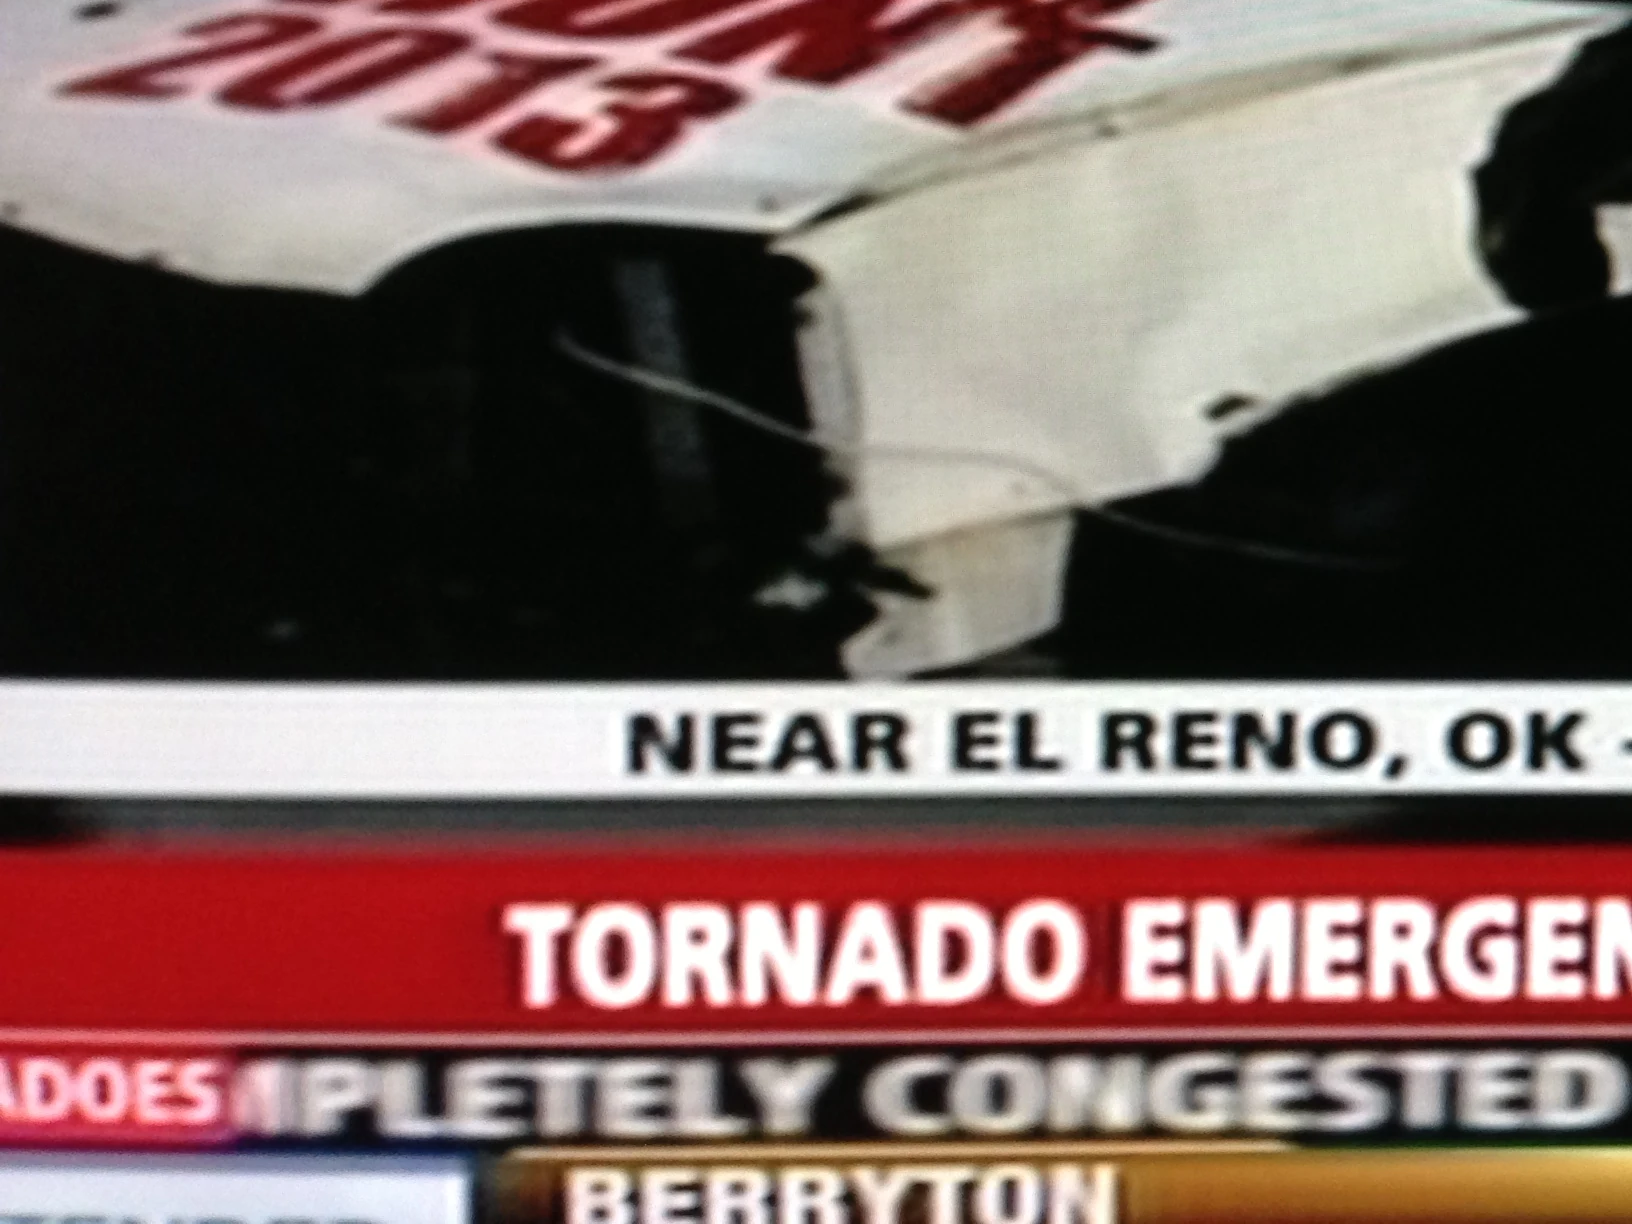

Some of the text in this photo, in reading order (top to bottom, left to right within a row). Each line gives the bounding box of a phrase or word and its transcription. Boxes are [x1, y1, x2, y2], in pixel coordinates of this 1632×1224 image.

[50, 11, 755, 176] 2013
[626, 710, 910, 774] NEAR
[948, 710, 1062, 774] EL
[1098, 710, 1408, 780] RENO,
[1444, 710, 1587, 774] OK
[503, 899, 1086, 1008] TORNADO
[862, 1051, 1632, 1136] CONGESTED
[563, 1165, 1120, 1224] BERRYTON
